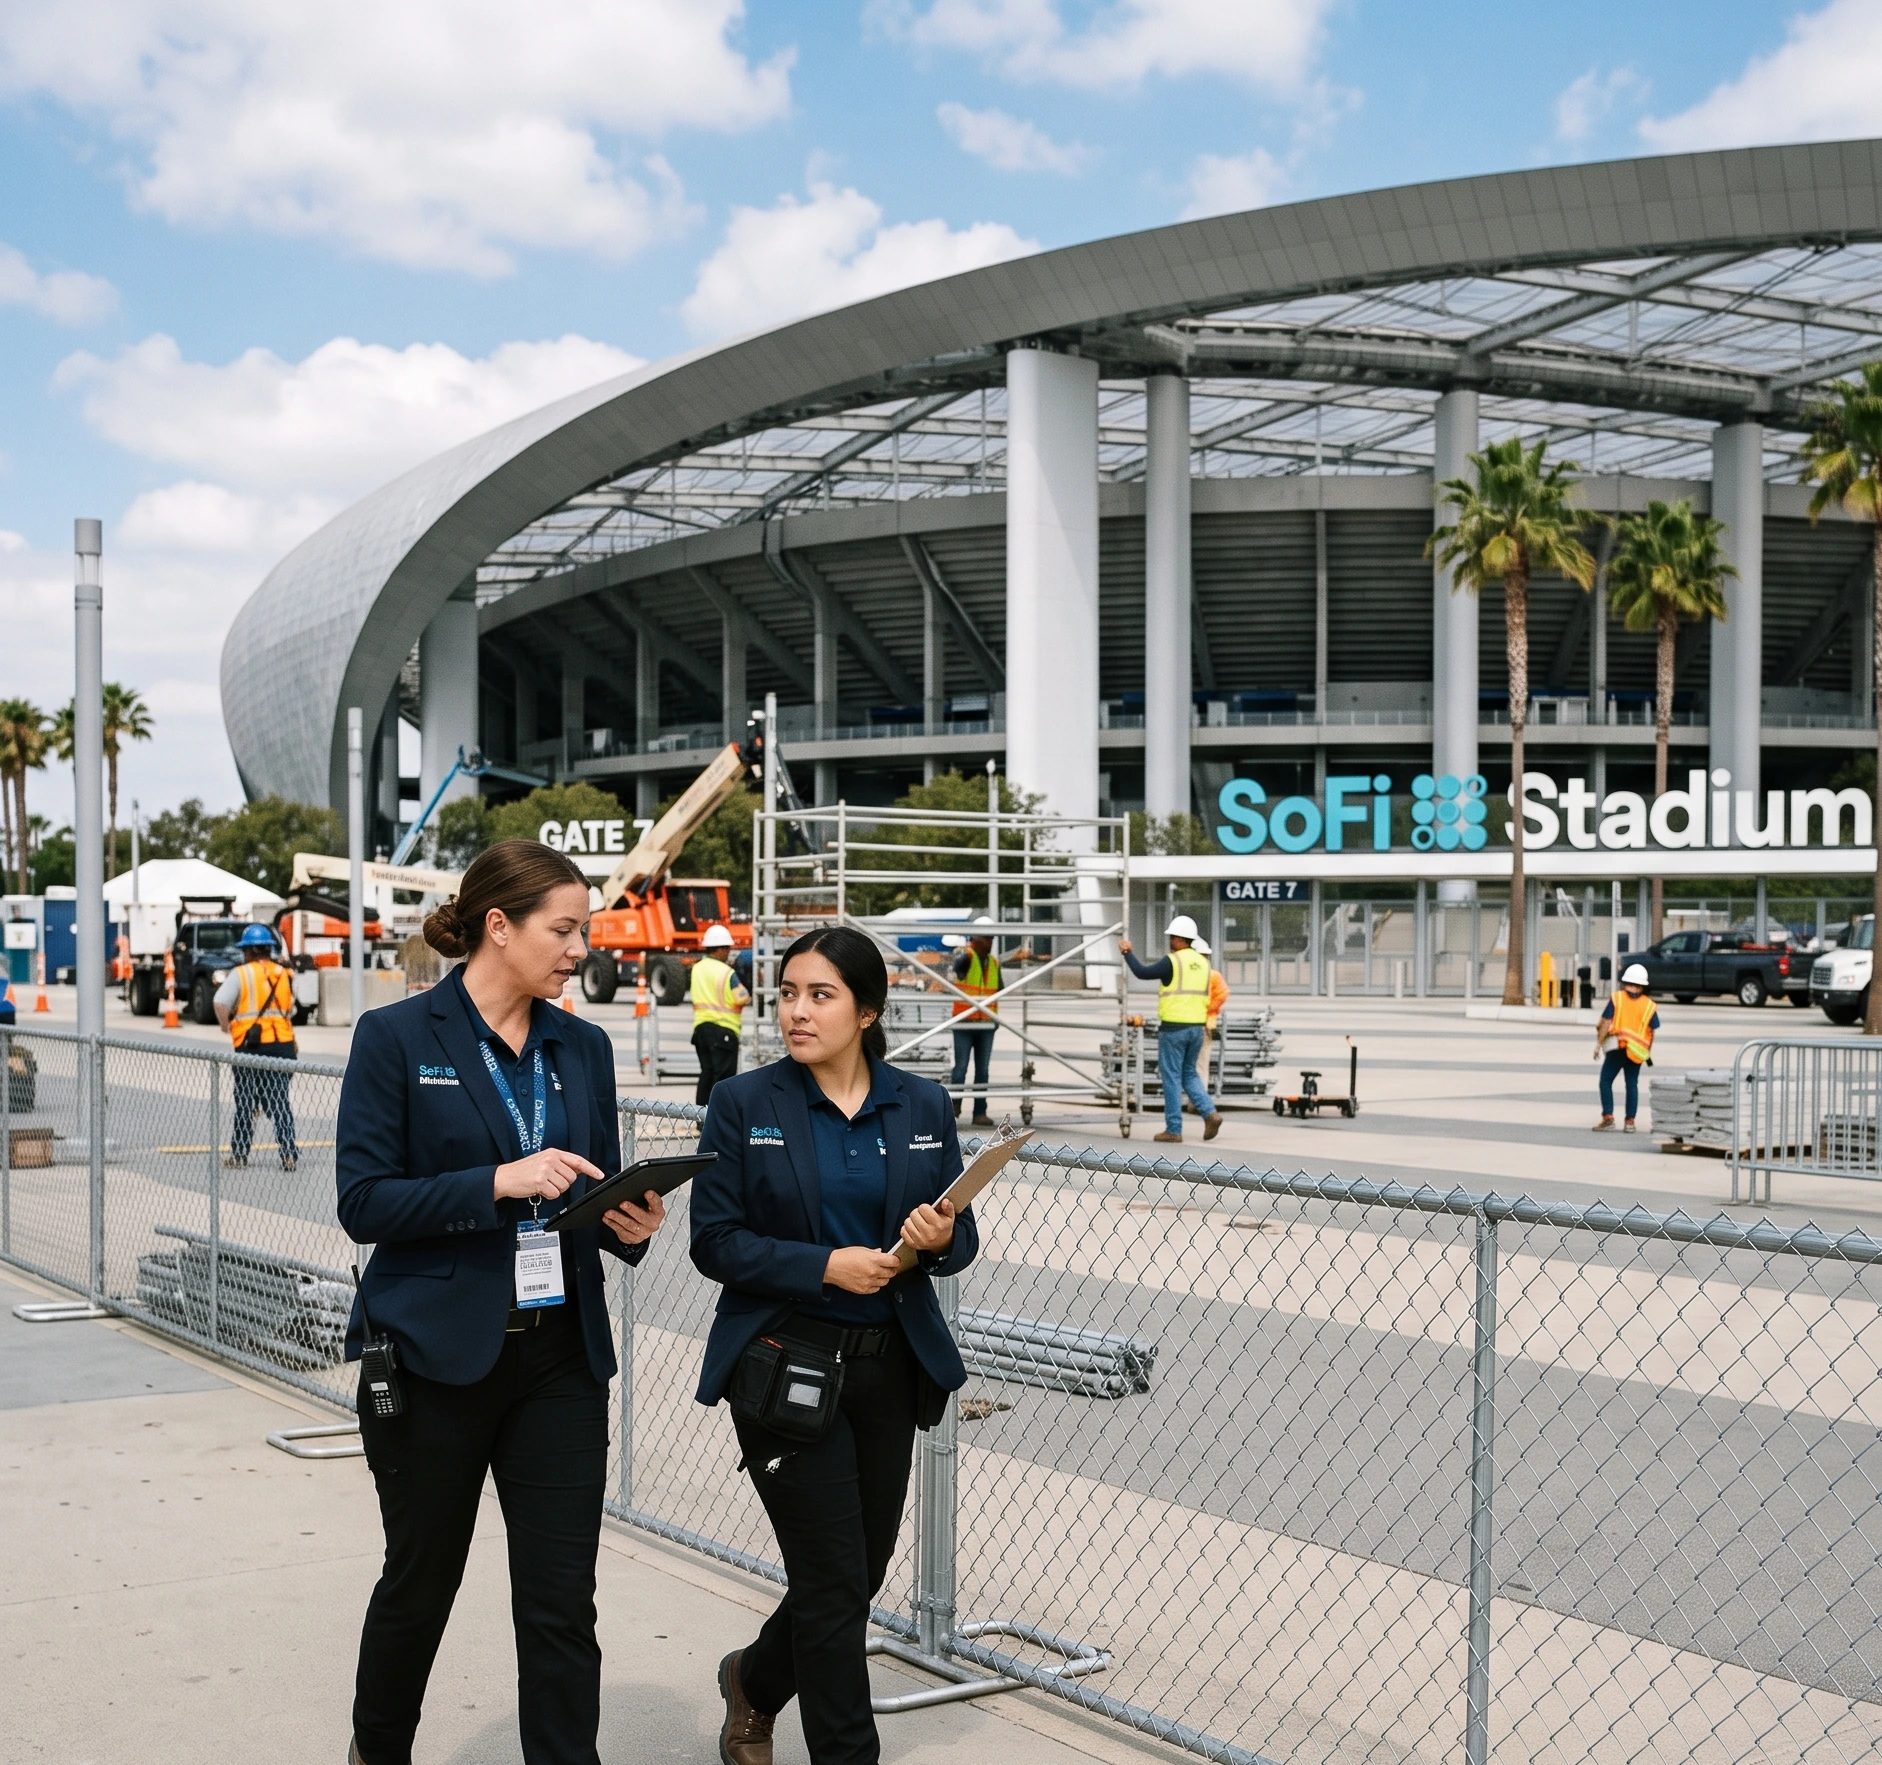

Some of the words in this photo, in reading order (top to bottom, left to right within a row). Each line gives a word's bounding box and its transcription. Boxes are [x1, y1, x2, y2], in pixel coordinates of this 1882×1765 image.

[1216, 773, 1392, 854] SoFi
[1504, 768, 1873, 850] Stadium
[539, 819, 625, 853] GATE
[1226, 881, 1280, 899] GATE
[1285, 881, 1298, 899] 7
